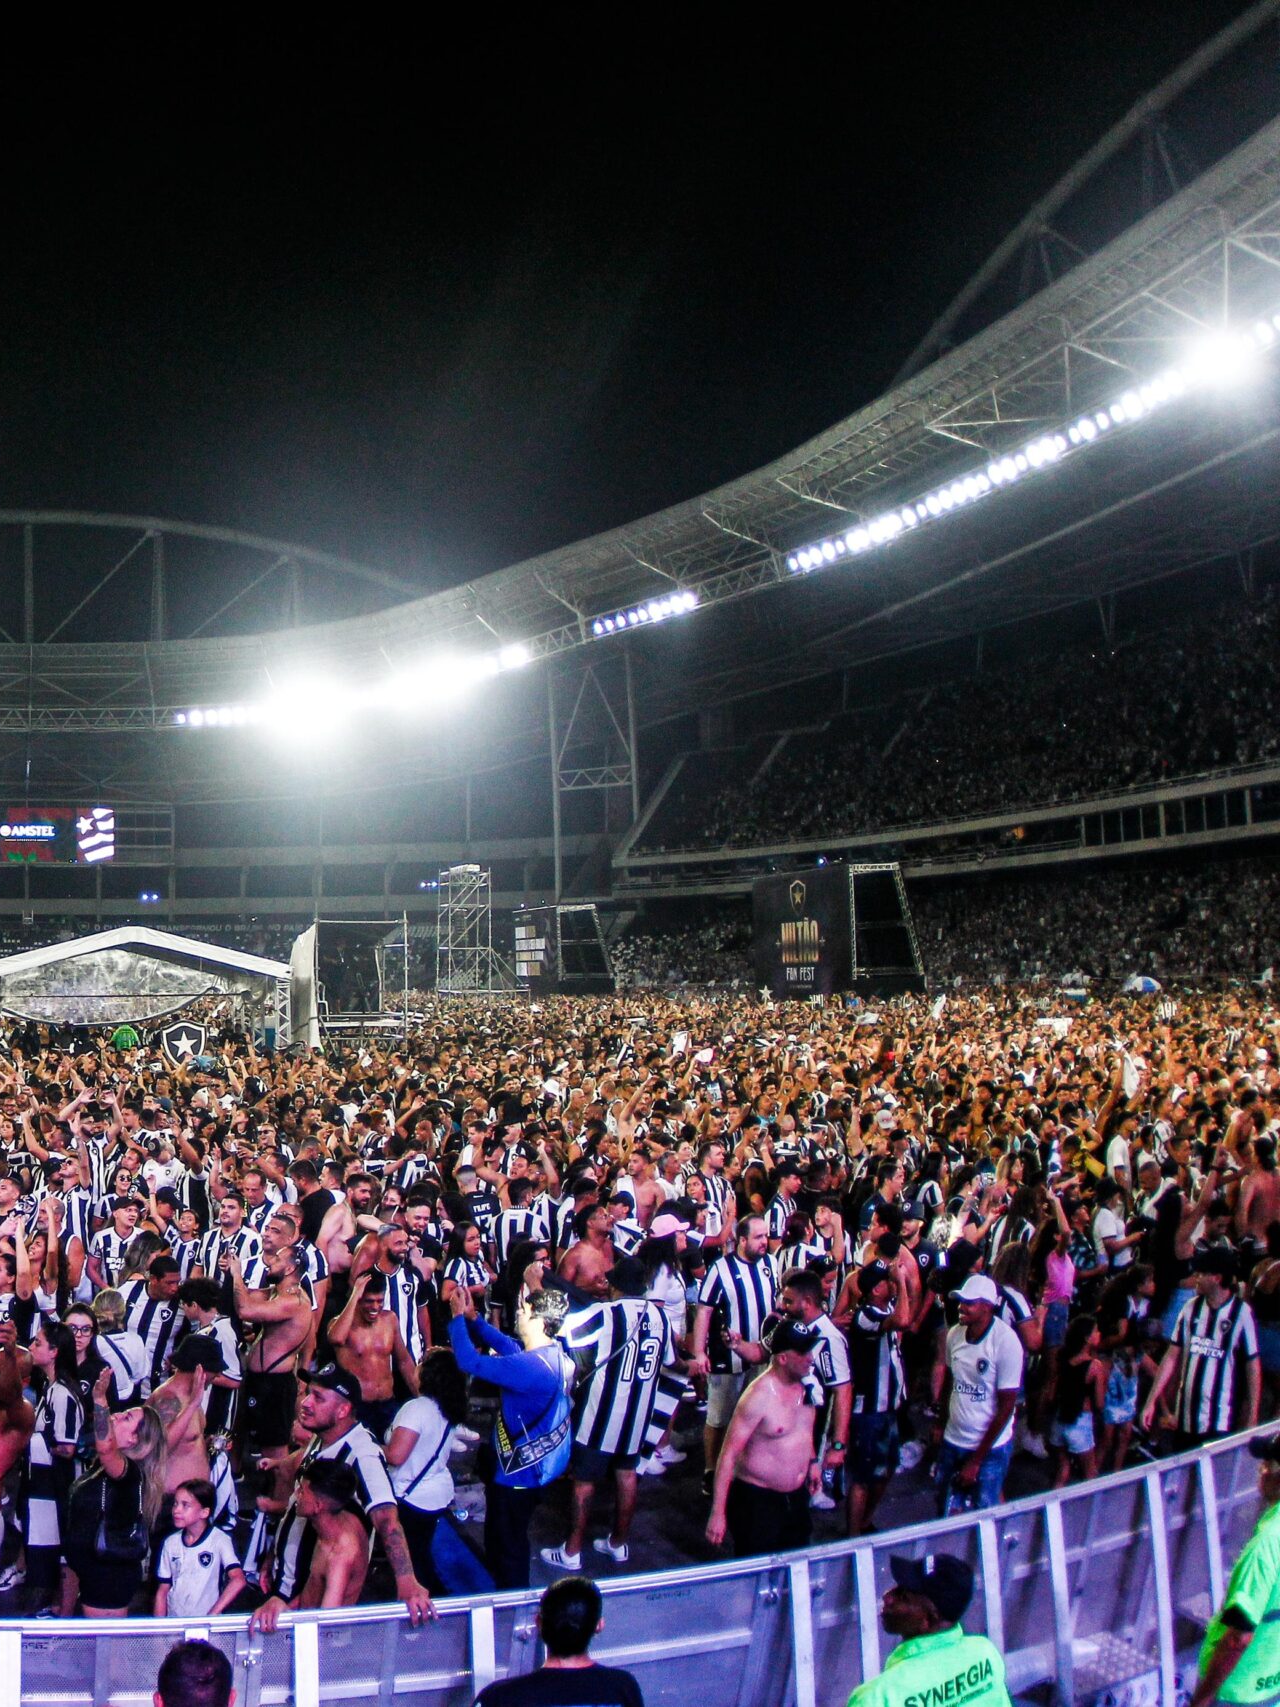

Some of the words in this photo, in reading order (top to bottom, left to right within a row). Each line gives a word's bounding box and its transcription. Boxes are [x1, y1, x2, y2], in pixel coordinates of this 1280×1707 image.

[11, 825, 56, 837] AMSTEL
[799, 967, 815, 981] FEST
[621, 1337, 661, 1382] 13
